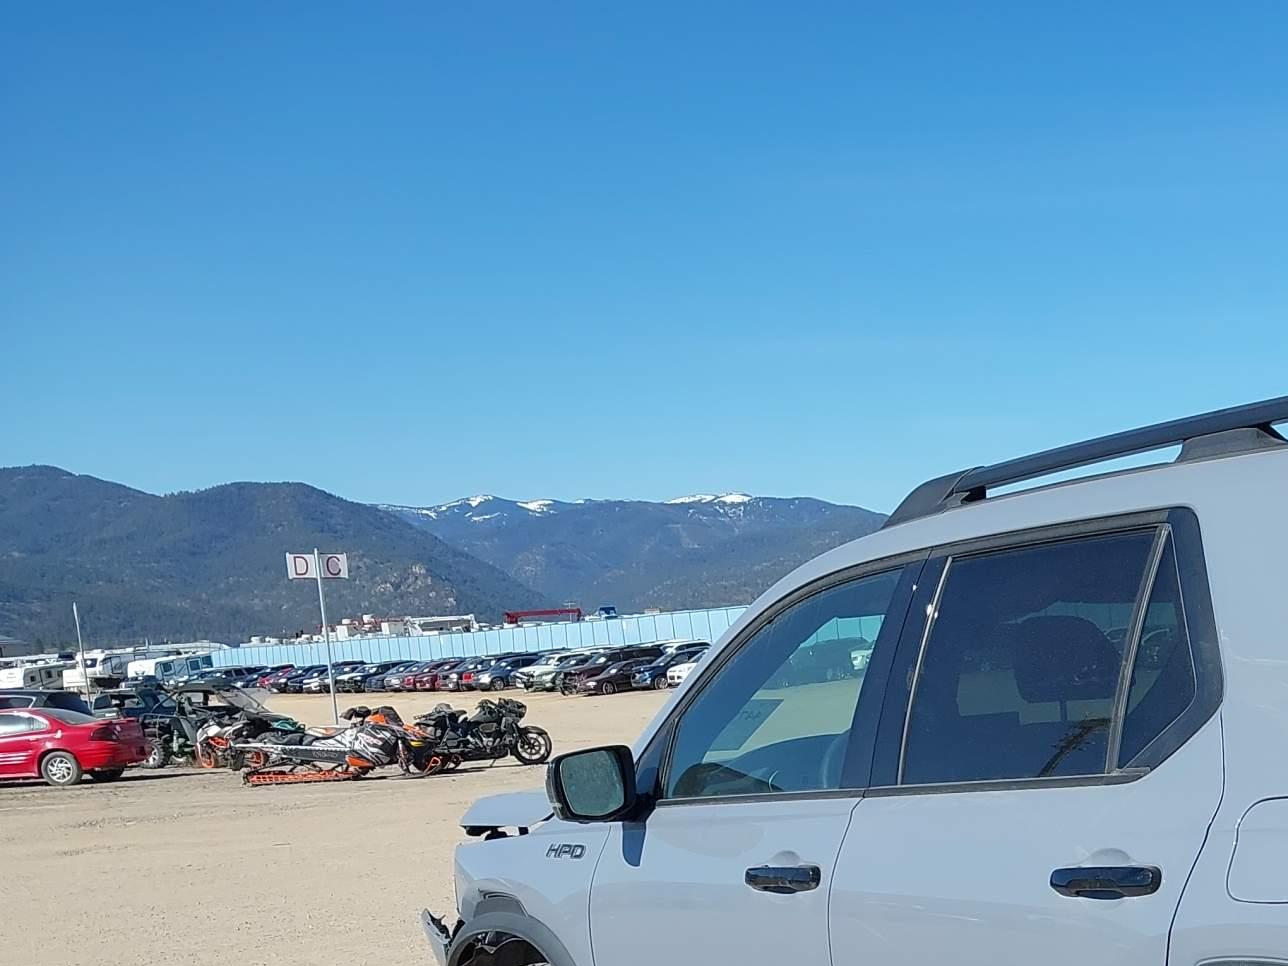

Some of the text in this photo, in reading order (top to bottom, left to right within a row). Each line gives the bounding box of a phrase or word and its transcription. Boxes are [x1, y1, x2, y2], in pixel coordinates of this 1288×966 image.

[293, 555, 309, 576] D
[325, 555, 342, 576] C
[545, 843, 587, 859] HPD
